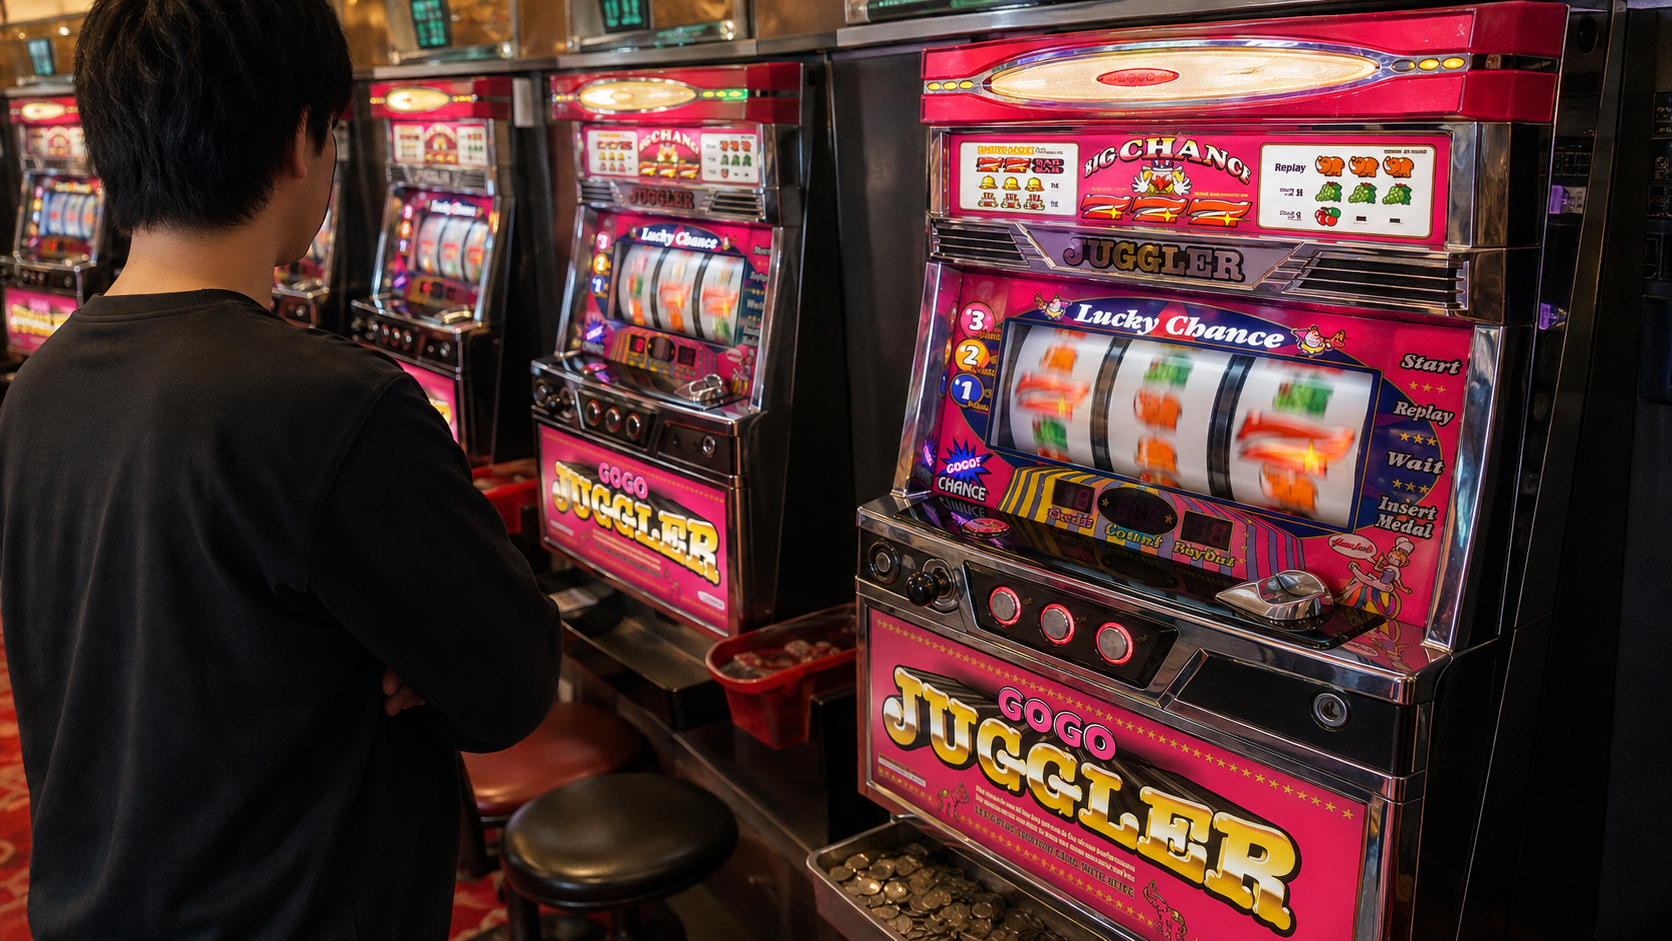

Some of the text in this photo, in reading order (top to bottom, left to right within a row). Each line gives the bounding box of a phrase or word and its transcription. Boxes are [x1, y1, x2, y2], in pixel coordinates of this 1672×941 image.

[1084, 136, 1252, 185] BIG CHANCE
[1274, 162, 1307, 174] Replay
[630, 188, 694, 209] JUGGLER
[1064, 237, 1245, 283] JUGGLER
[968, 310, 985, 331] 3
[1073, 304, 1285, 349] Lucky Chance
[963, 345, 979, 366] 2
[1400, 354, 1462, 375] Start
[961, 381, 973, 400] 1
[1393, 400, 1454, 426] Replay
[1387, 451, 1446, 476] Wait
[598, 462, 649, 499] GOGO
[938, 476, 987, 502] CHANCE
[1377, 496, 1438, 521] Insert
[552, 460, 721, 586] JUGGLER
[1374, 514, 1433, 539] Medal
[997, 685, 1117, 761] GOGO
[882, 665, 1302, 937] JUGGLER
